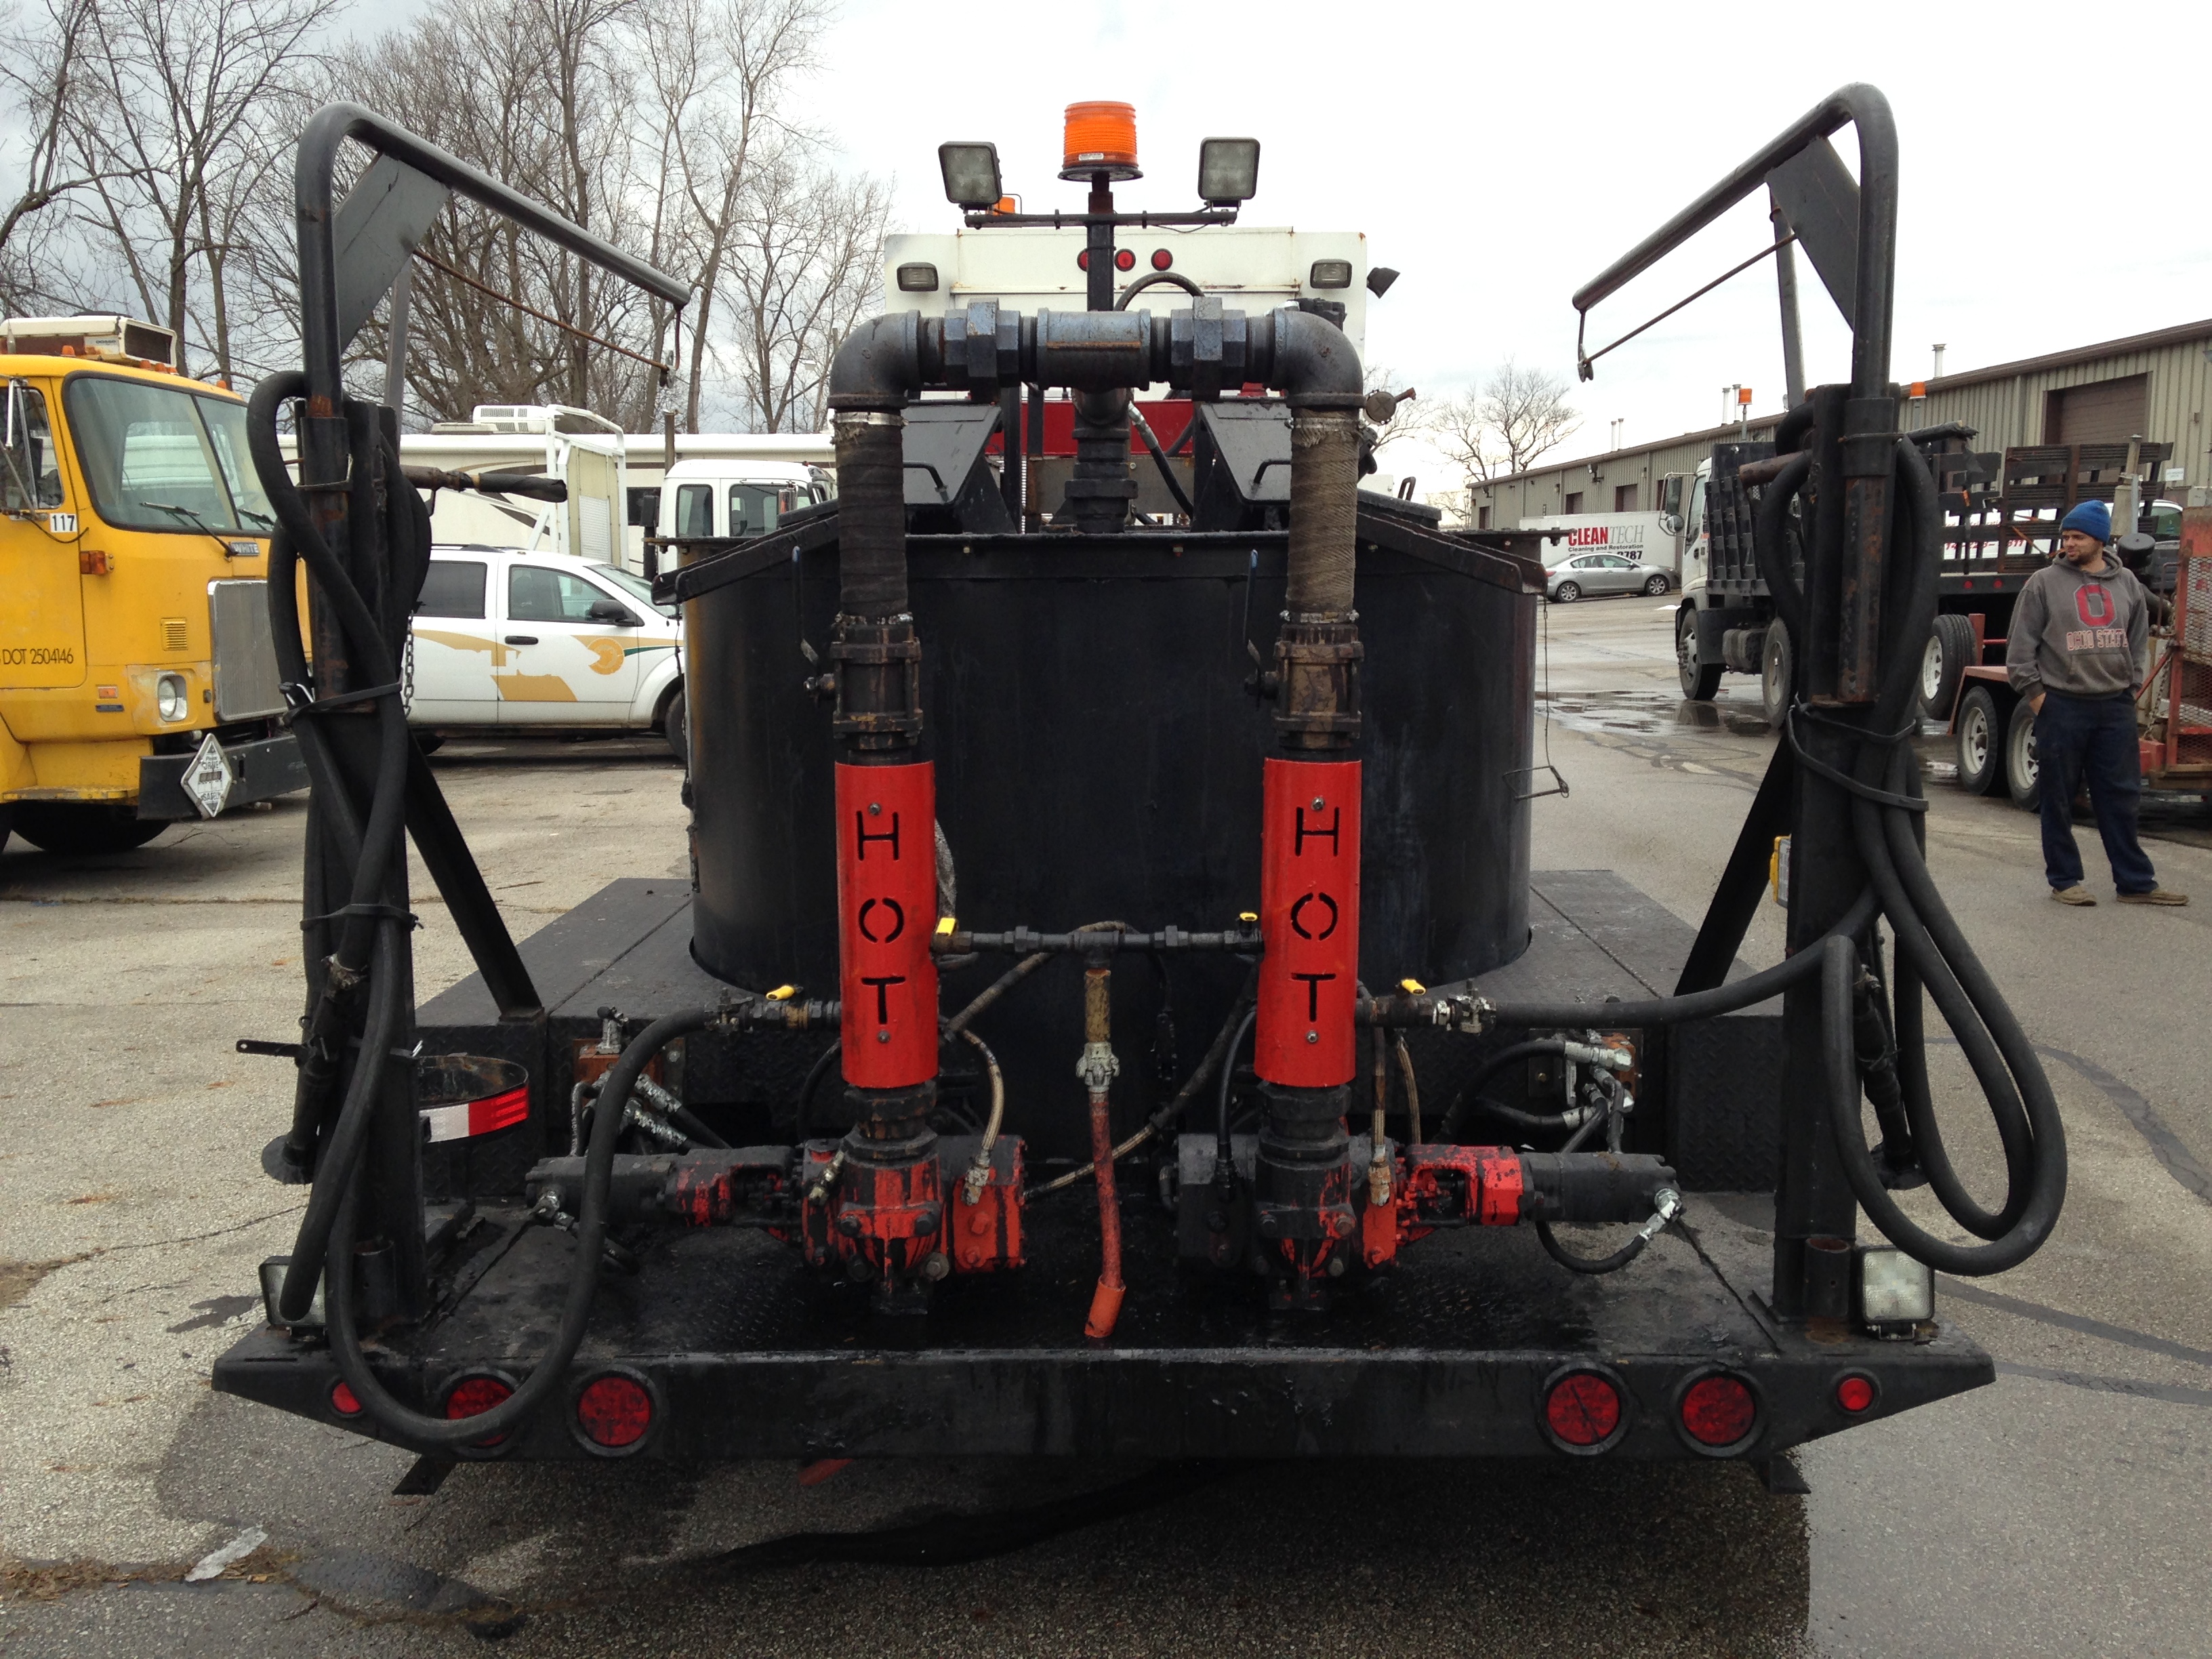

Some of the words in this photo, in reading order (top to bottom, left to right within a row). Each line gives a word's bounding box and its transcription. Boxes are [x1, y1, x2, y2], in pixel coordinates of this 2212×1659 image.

[52, 514, 75, 531] 117
[2074, 583, 2116, 628] O
[2, 648, 27, 665] DOT
[29, 648, 74, 665] 2504146
[2066, 630, 2095, 651] OHIO
[857, 811, 905, 1024] HOT
[1290, 806, 1340, 1022] HOT
